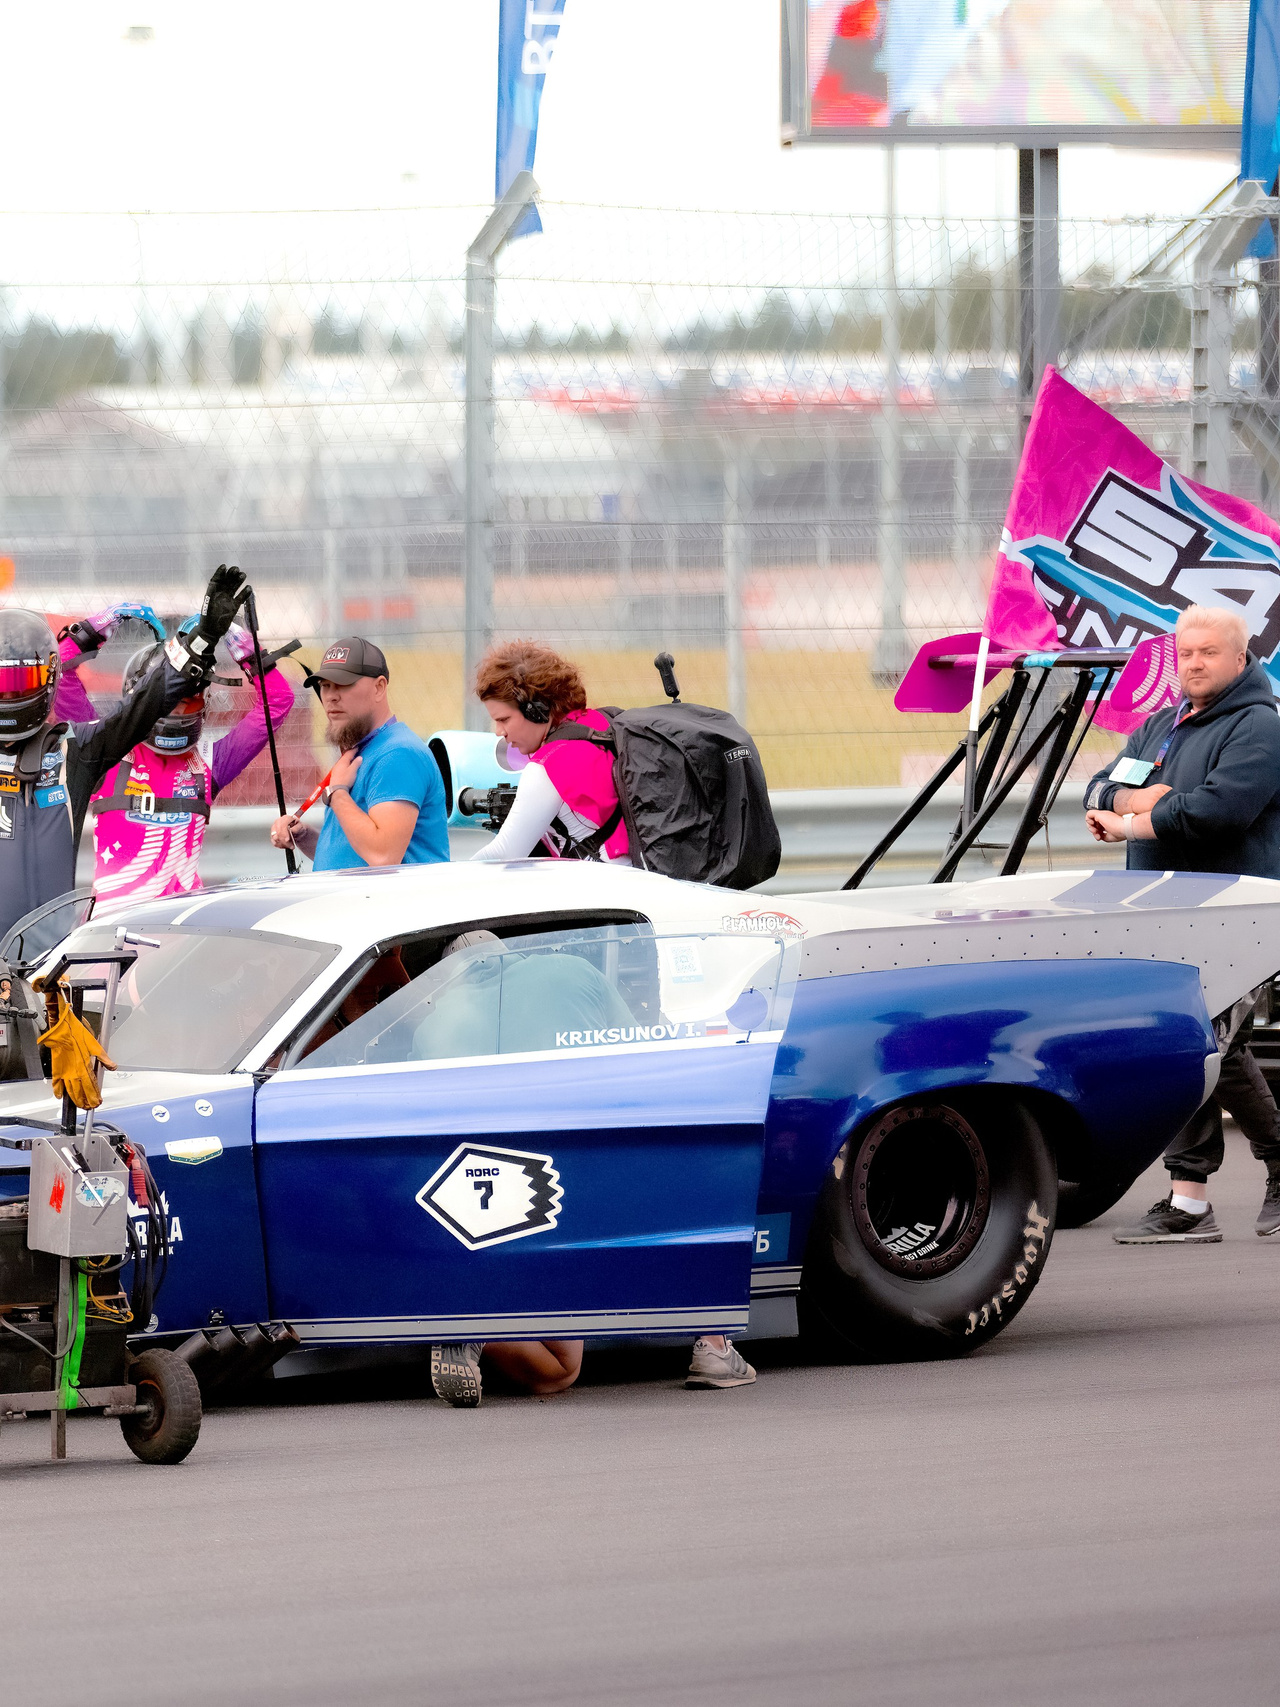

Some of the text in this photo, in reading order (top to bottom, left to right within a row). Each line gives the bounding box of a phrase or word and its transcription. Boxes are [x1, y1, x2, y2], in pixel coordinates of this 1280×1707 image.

[554, 1022, 681, 1047] KRIKSUNOV
[473, 1180, 494, 1210] 7
[886, 1222, 937, 1254] RILLA
[916, 1240, 940, 1257] DRINK
